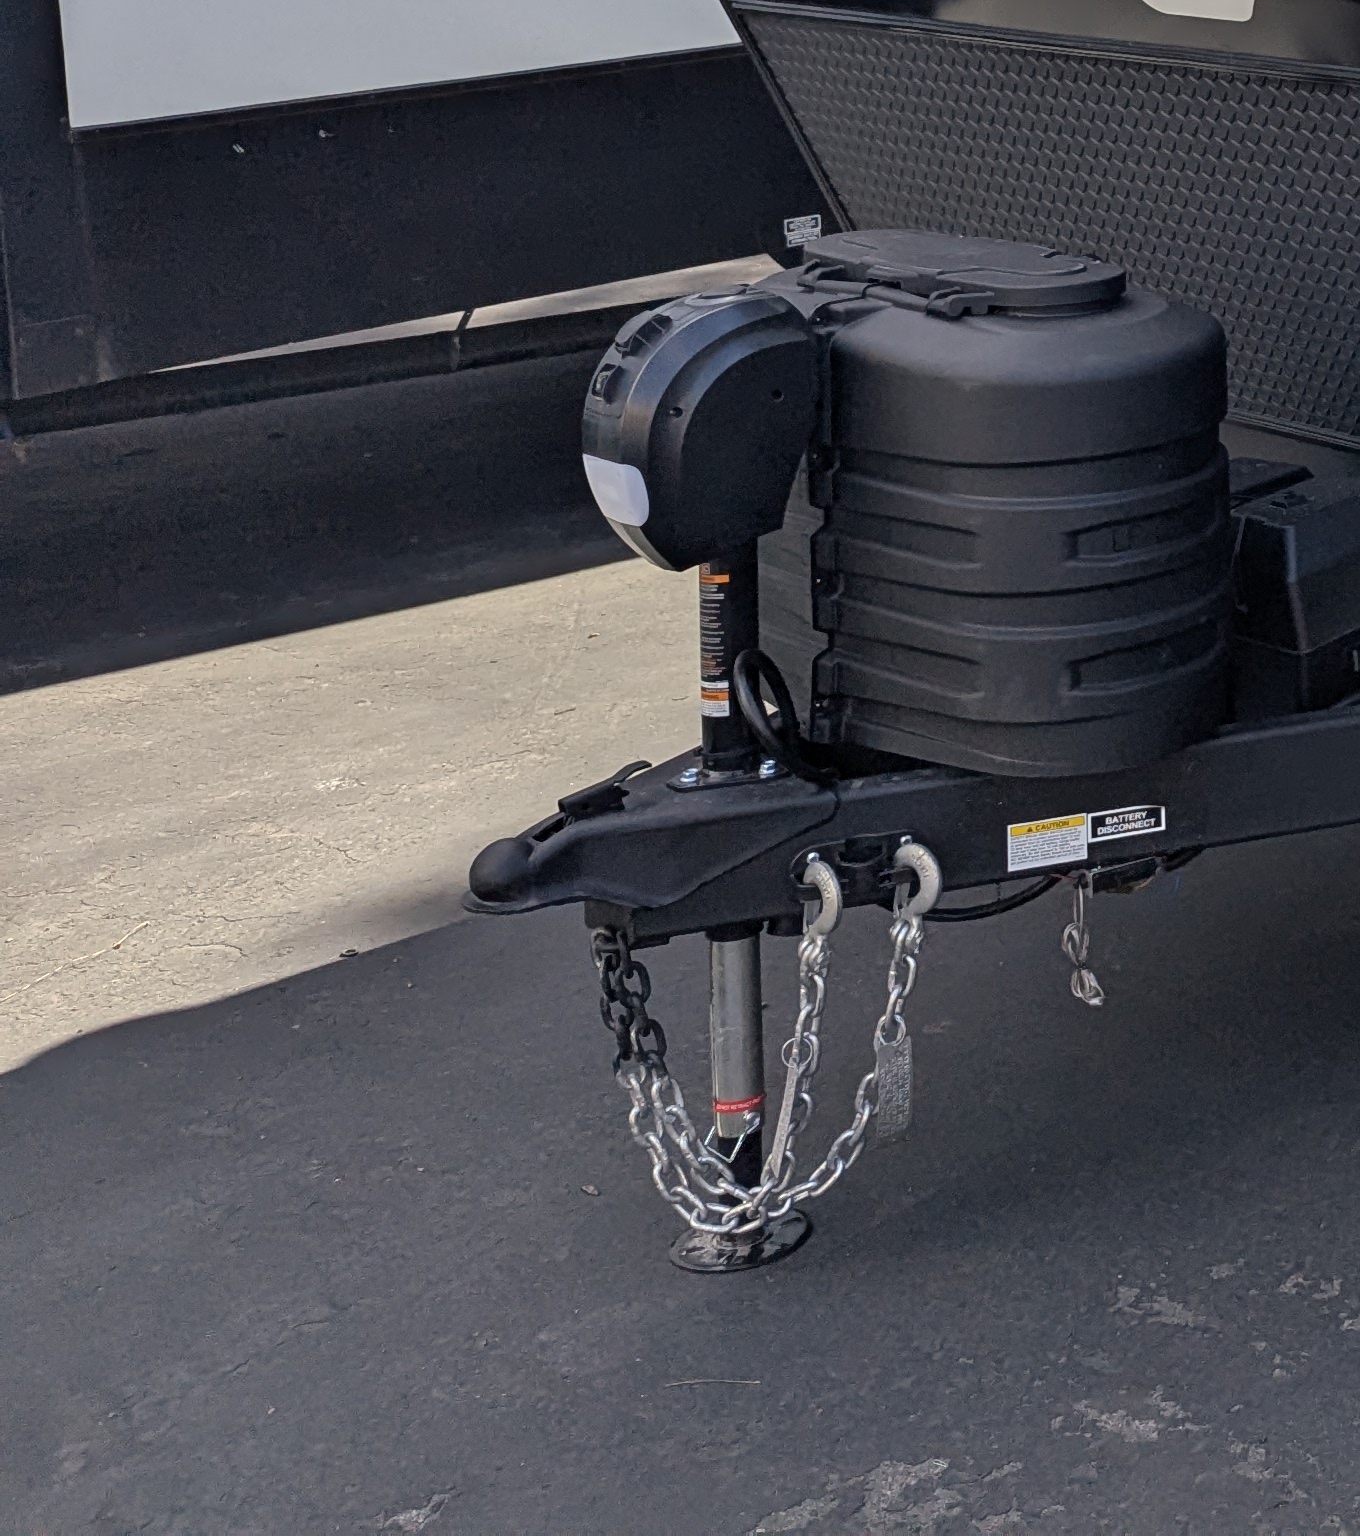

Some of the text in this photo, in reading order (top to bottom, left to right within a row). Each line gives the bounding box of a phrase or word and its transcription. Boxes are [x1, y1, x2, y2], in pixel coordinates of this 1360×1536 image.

[1105, 810, 1147, 825] BATTERY
[1035, 820, 1070, 832] CAUTION
[1097, 817, 1156, 836] DISCONNECT
